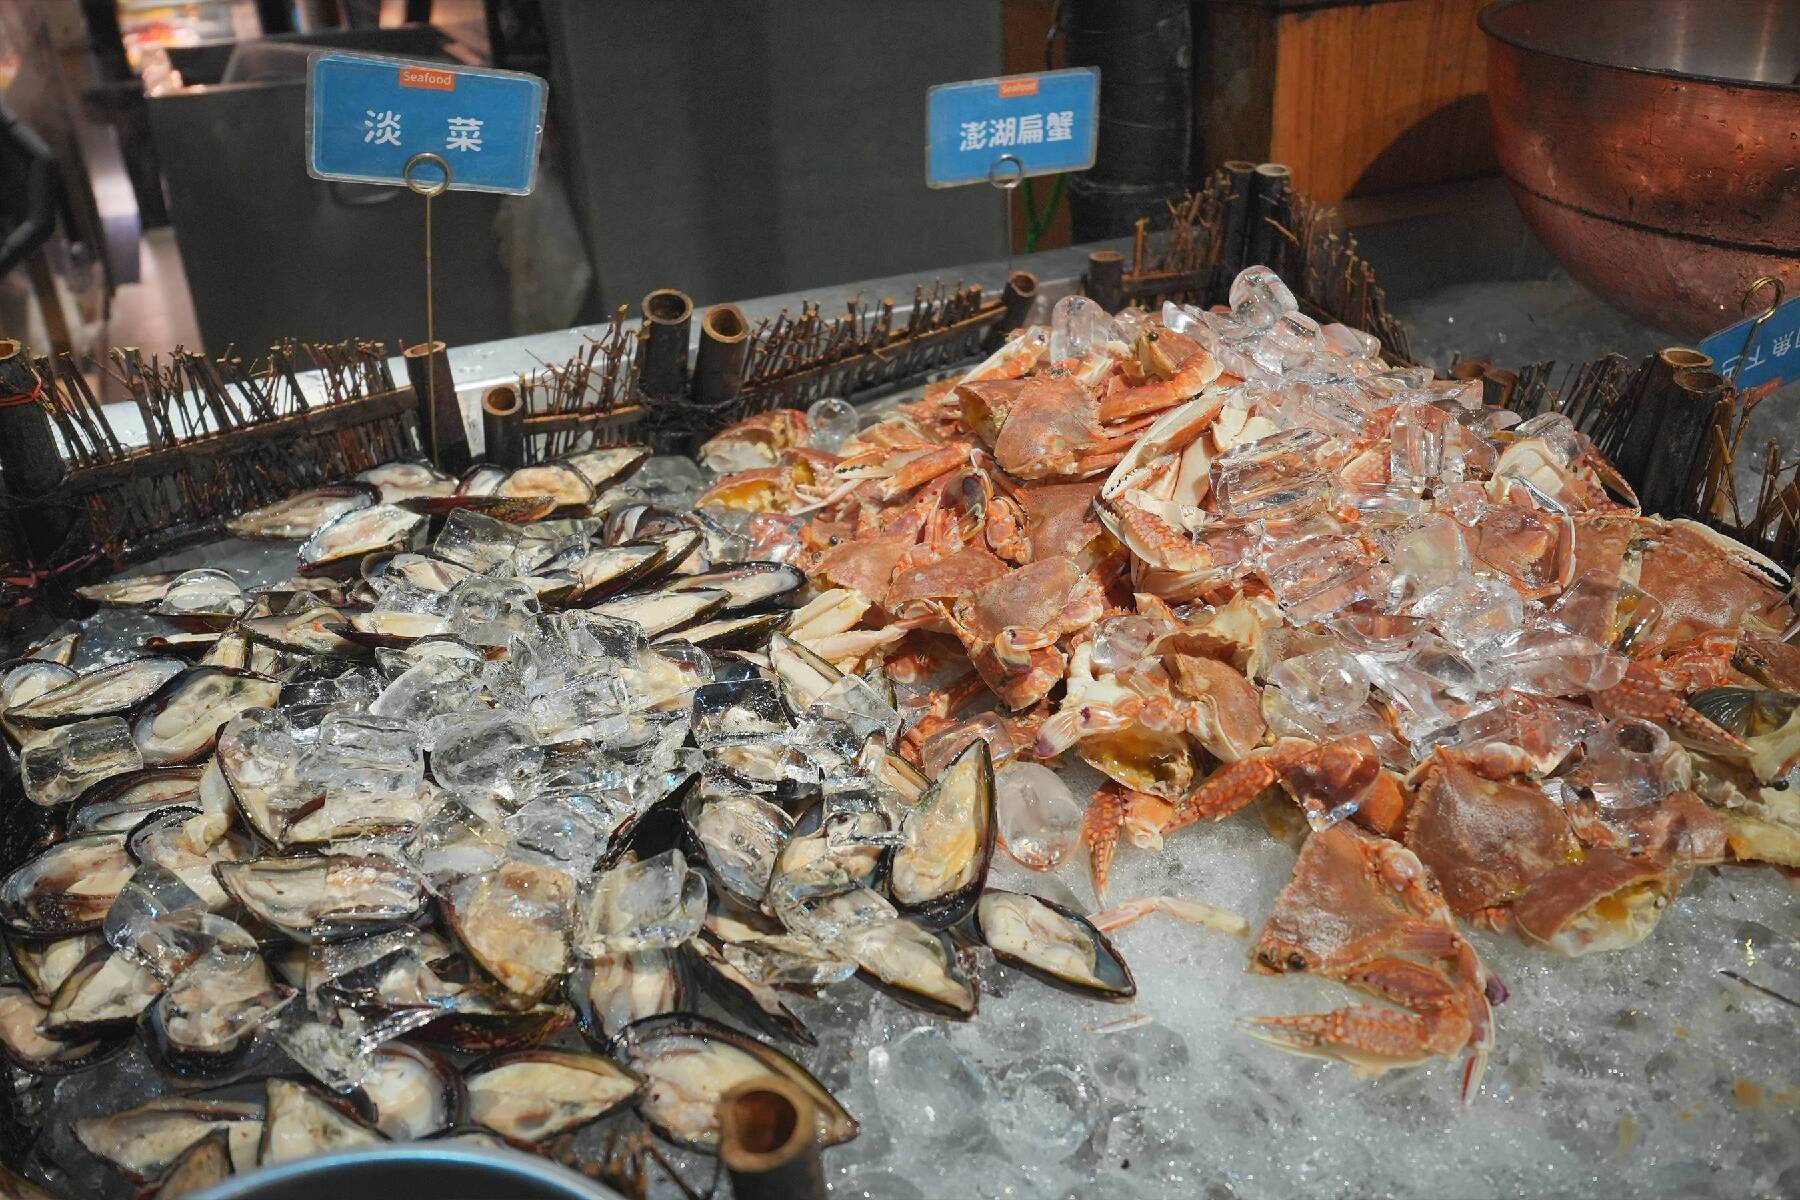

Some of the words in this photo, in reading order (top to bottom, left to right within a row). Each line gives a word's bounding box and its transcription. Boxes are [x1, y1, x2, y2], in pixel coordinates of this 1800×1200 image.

[403, 71, 452, 85] Seafood
[959, 110, 1074, 151] 澎湖扁蟹
